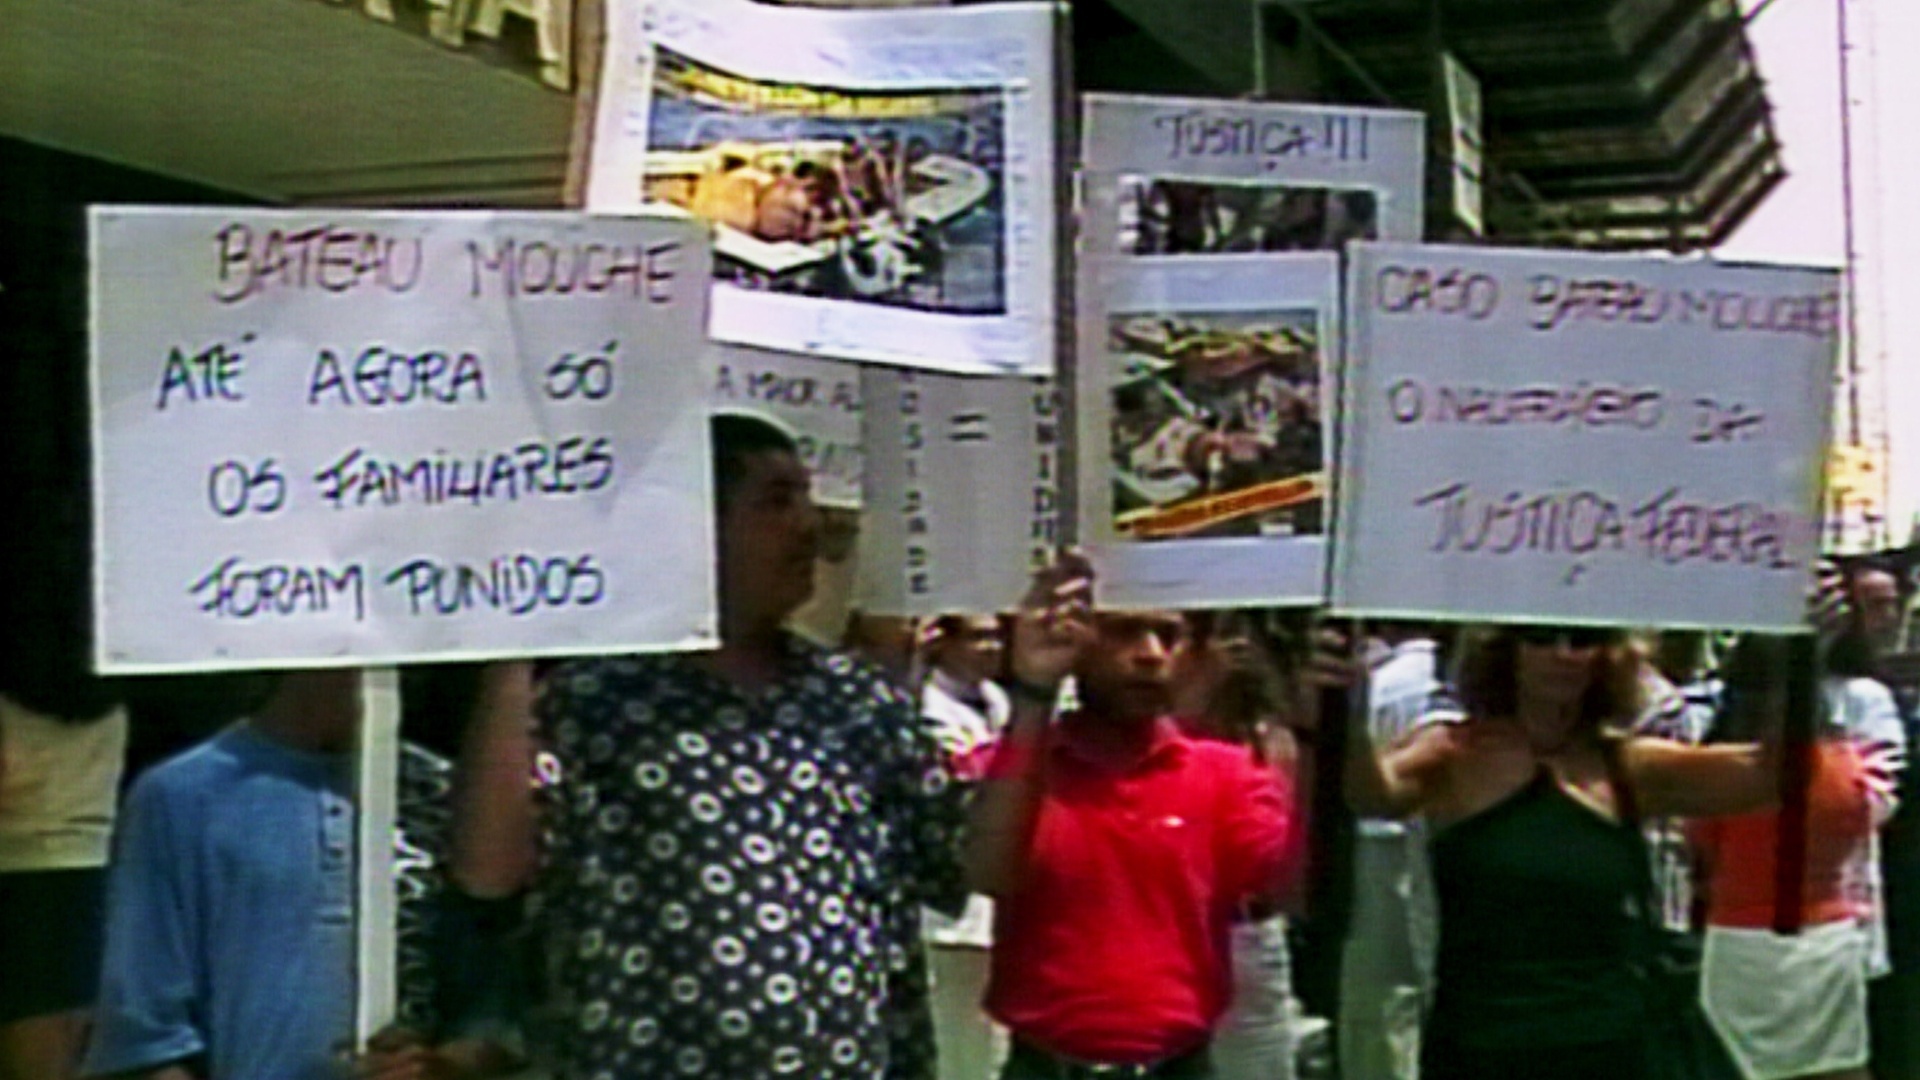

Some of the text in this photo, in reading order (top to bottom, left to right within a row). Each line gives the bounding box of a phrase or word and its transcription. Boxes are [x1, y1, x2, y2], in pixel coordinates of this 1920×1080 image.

[212, 222, 682, 303] BATEAU MOUCHE
[1376, 265, 1840, 338] CASO BATEAU MOUCHE
[157, 333, 618, 410] ATÉ AGORA SÓ
[1388, 380, 1424, 424] O
[1690, 398, 1765, 443] DA
[207, 437, 615, 517] OS FAMILIARES
[1413, 481, 1800, 585] JUSTIÇA FEDERAL
[187, 555, 606, 621] FORAM PUNIDOS
